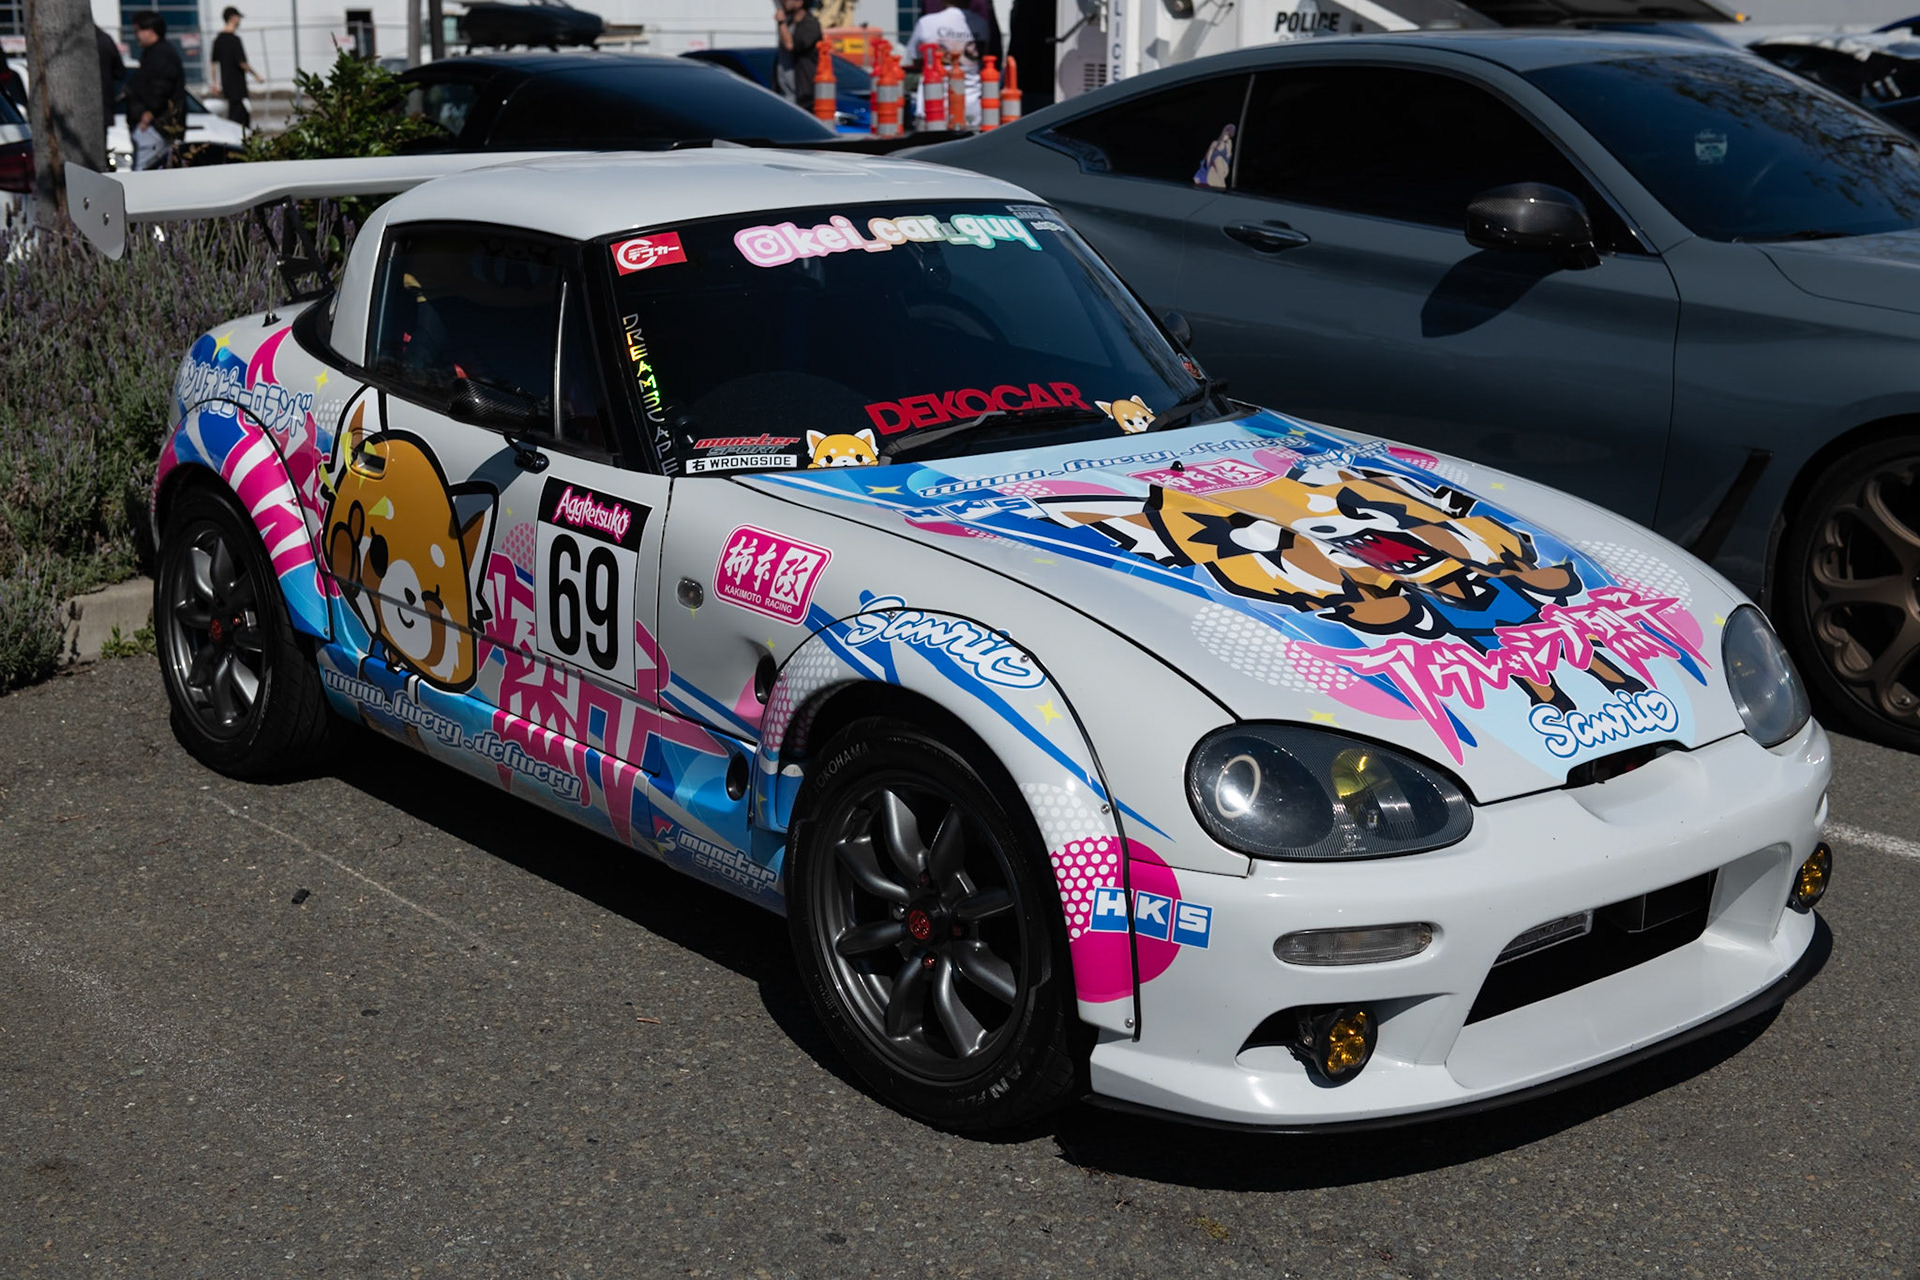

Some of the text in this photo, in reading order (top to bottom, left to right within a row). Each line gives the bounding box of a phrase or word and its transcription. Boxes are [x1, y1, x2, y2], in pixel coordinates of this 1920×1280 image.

[1275, 11, 1341, 33] POLICE
[864, 382, 1092, 436] DEKOCAR
[693, 433, 800, 449] monster
[706, 445, 786, 457] SPORT
[709, 456, 791, 468] WRONGSIDE
[549, 533, 619, 671] 69
[724, 584, 793, 614] KAKIMOTO RACING
[844, 595, 1046, 689] Sanrio
[1529, 691, 1678, 757] Sanrio
[680, 831, 776, 882] monster
[694, 854, 764, 892] SPORT
[1093, 887, 1211, 941] HKS
